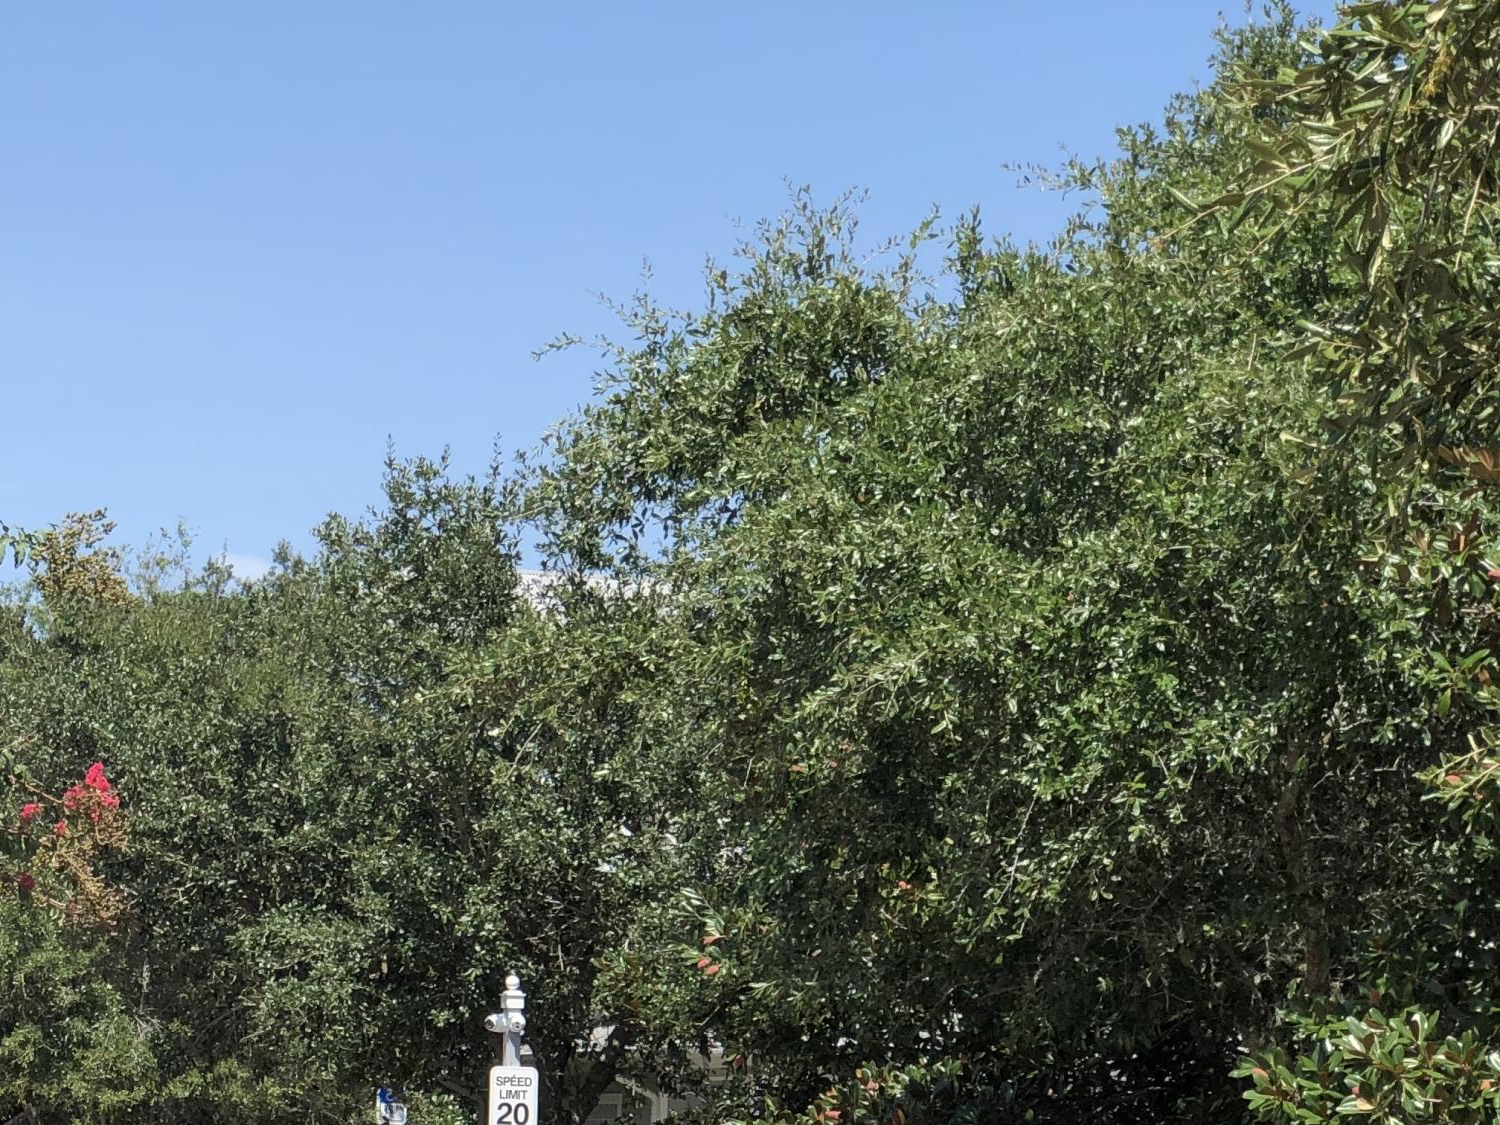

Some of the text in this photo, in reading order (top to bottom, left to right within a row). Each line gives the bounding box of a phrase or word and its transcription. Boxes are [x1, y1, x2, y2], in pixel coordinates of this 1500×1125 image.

[495, 1076, 533, 1087] SPEED
[499, 1090, 528, 1100] LIMIT
[496, 1103, 530, 1125] 20
